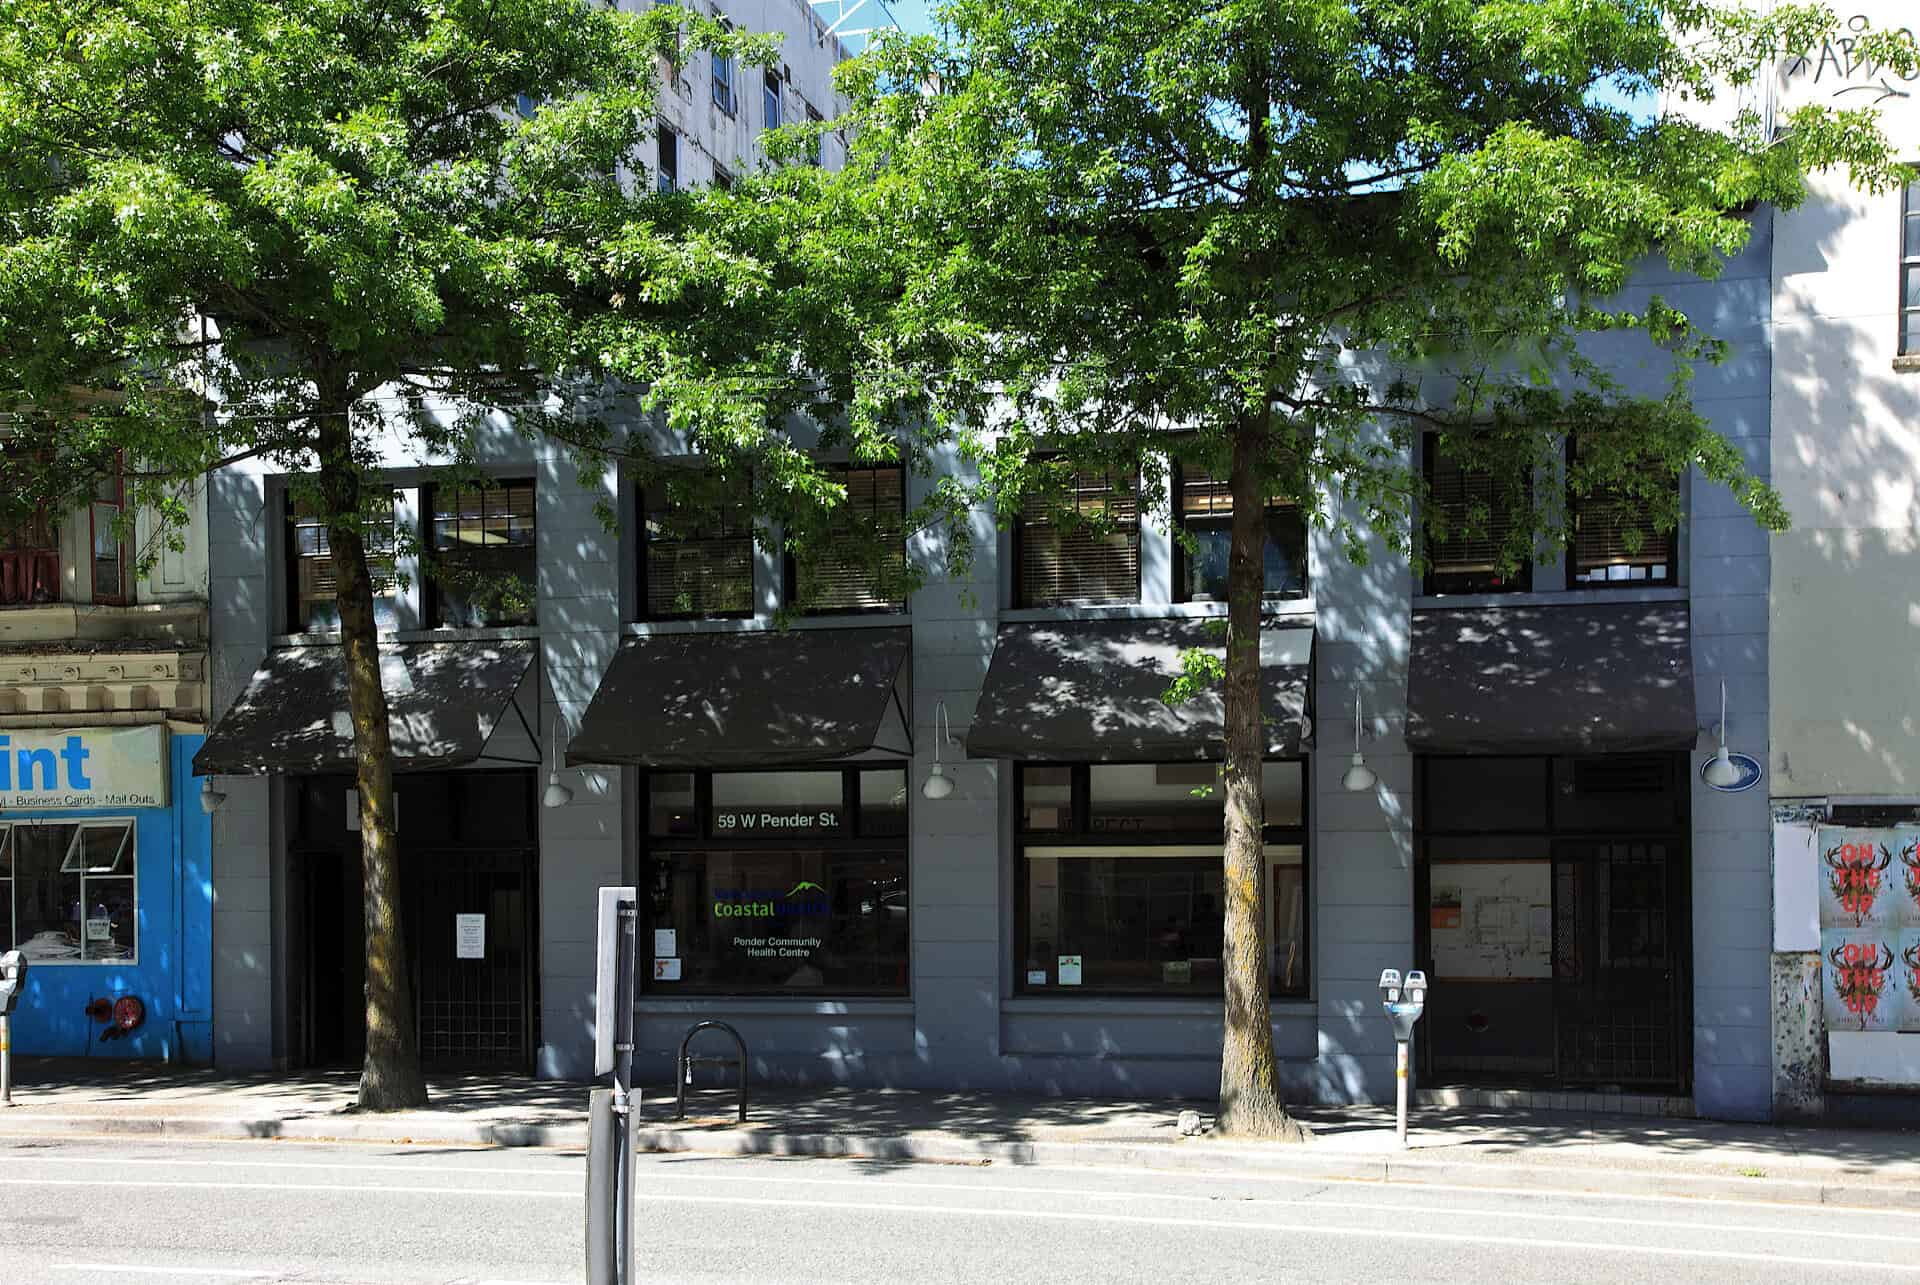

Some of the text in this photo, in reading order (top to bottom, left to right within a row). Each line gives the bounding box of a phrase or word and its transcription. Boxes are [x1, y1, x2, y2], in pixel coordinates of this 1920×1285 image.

[16, 796, 63, 806] Business
[64, 794, 96, 806] Cards
[105, 795, 127, 805] Mail
[129, 794, 155, 805] Outs
[718, 812, 839, 829] 59 W Pender St.
[1841, 843, 1873, 862] ON
[1835, 868, 1881, 887] THE
[714, 901, 775, 917] Coastal
[1843, 895, 1873, 912] UP
[733, 936, 821, 948] Pender Community
[747, 948, 810, 957] Health Centre
[1844, 943, 1876, 961] ON
[1839, 968, 1884, 988] THE
[1847, 993, 1878, 1013] UP
